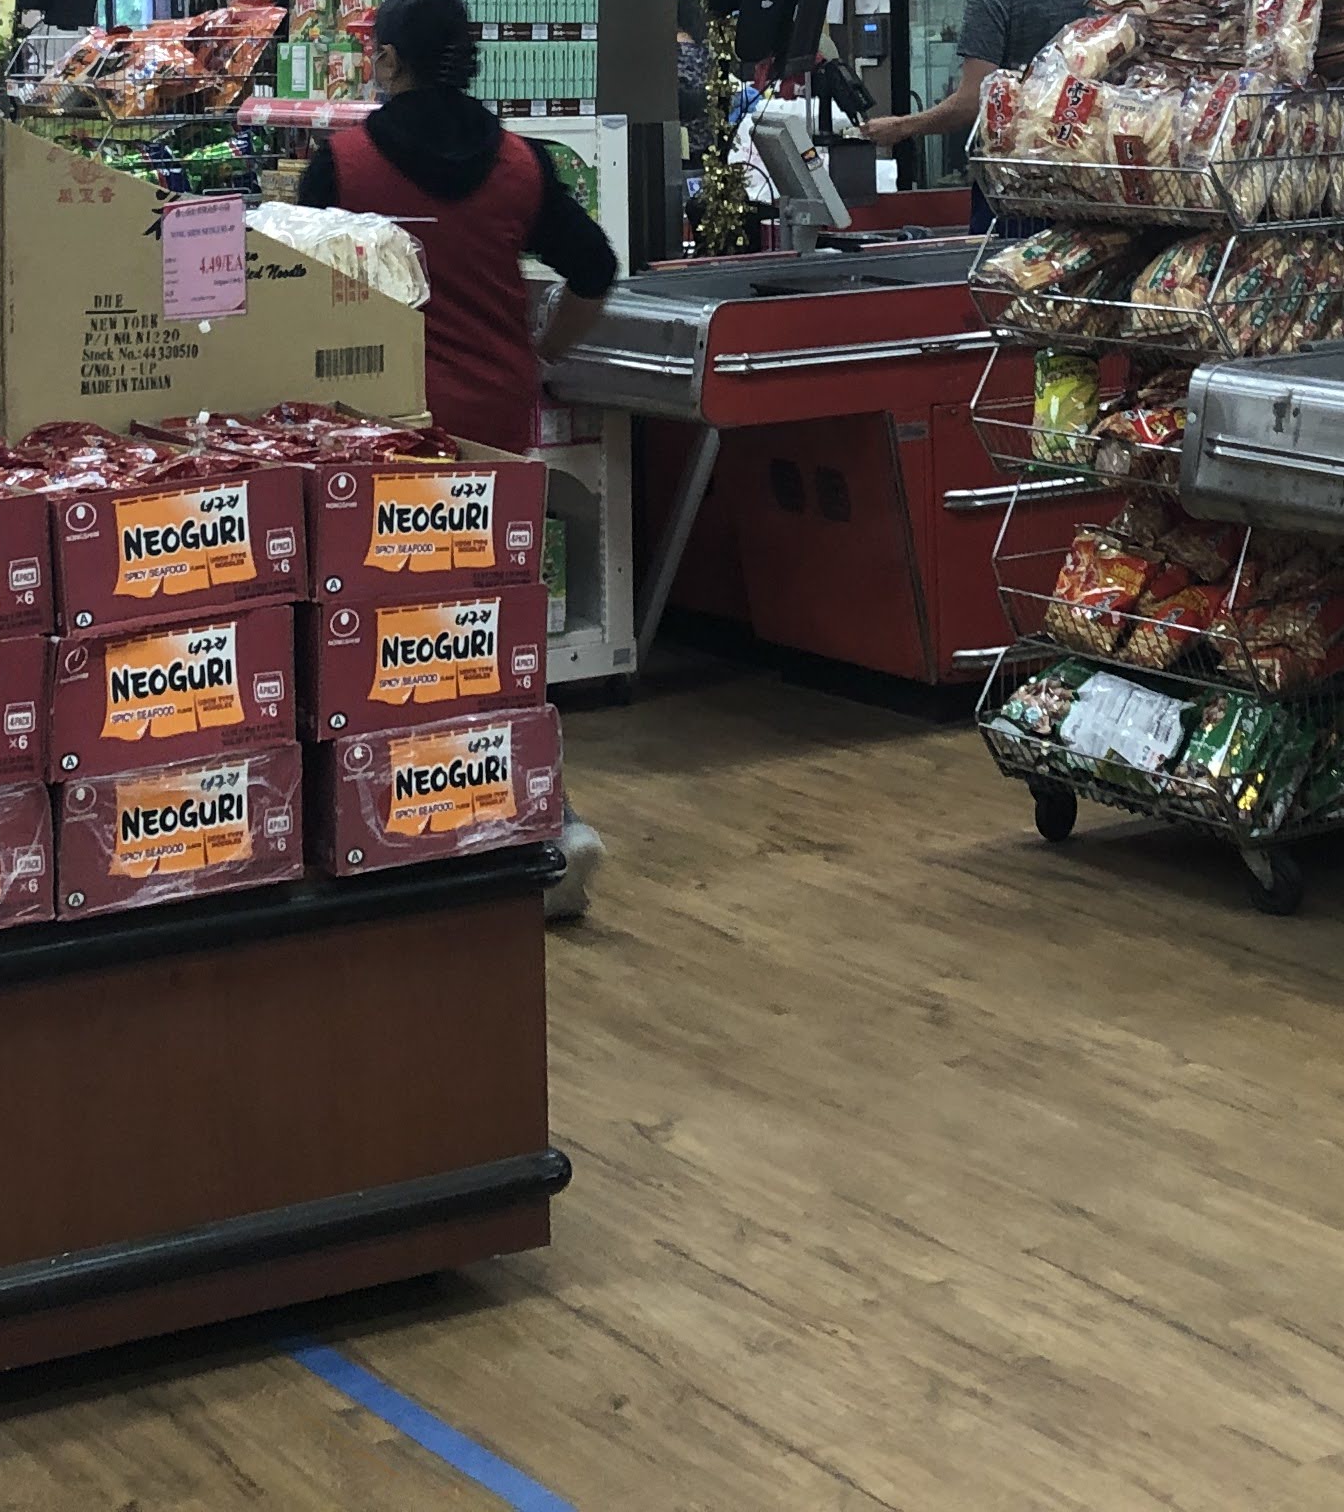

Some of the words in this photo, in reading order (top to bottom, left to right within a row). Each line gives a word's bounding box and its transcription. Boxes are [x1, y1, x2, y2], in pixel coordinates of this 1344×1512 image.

[199, 252, 244, 276] 4.49/EA
[266, 264, 307, 280] Noodle
[90, 316, 117, 331] NEW
[121, 314, 158, 329] YORK
[82, 347, 115, 361] Stock
[80, 379, 112, 395] MADE
[114, 378, 128, 393] IN
[130, 375, 172, 392] TAIWAN
[377, 502, 489, 535] NEOGURI
[123, 515, 245, 562] NEOGURI
[381, 630, 494, 669] NEOGURI
[111, 657, 233, 704] NEOGURI
[395, 755, 507, 801] NEOGURI
[121, 792, 243, 842] NEOGURI
